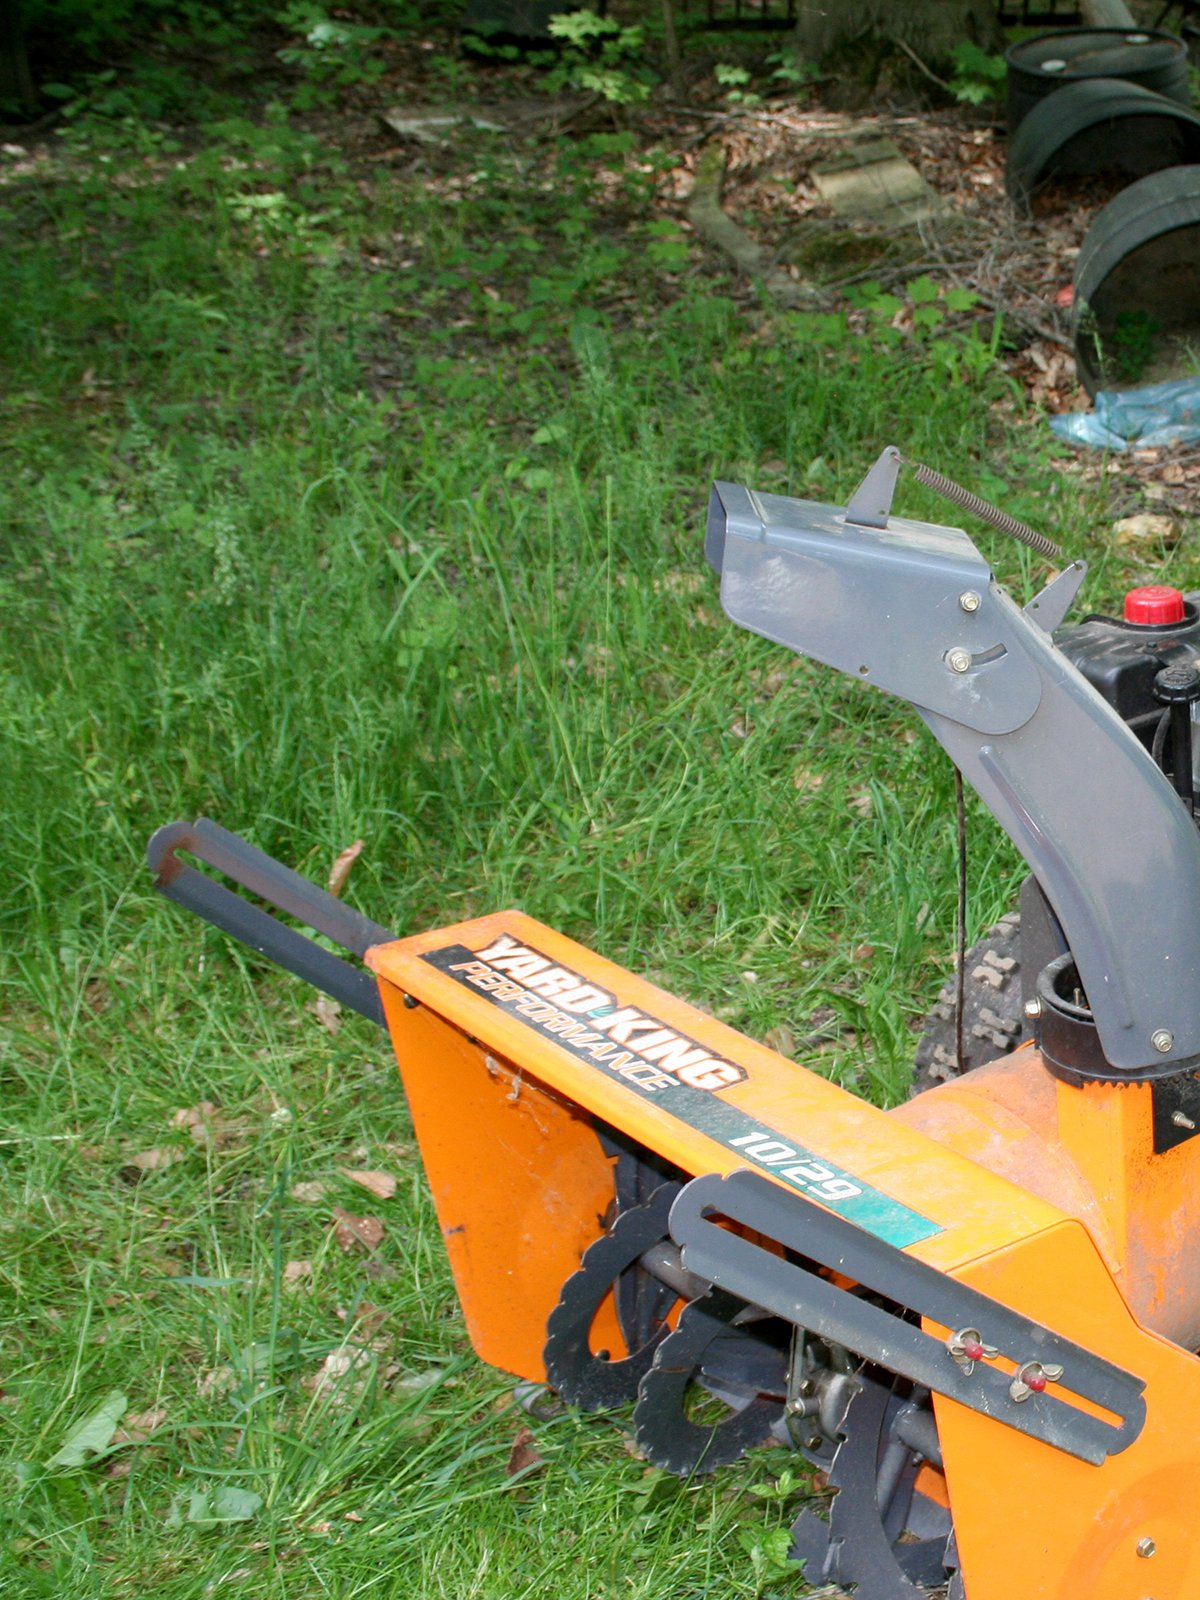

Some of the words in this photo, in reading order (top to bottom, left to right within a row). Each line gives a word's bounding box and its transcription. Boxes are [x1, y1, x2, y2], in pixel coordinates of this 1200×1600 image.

[448, 960, 682, 1092] PERFORMANCE
[472, 935, 613, 1014] YARD
[587, 1006, 743, 1091] KING
[728, 1131, 863, 1201] 10/29
